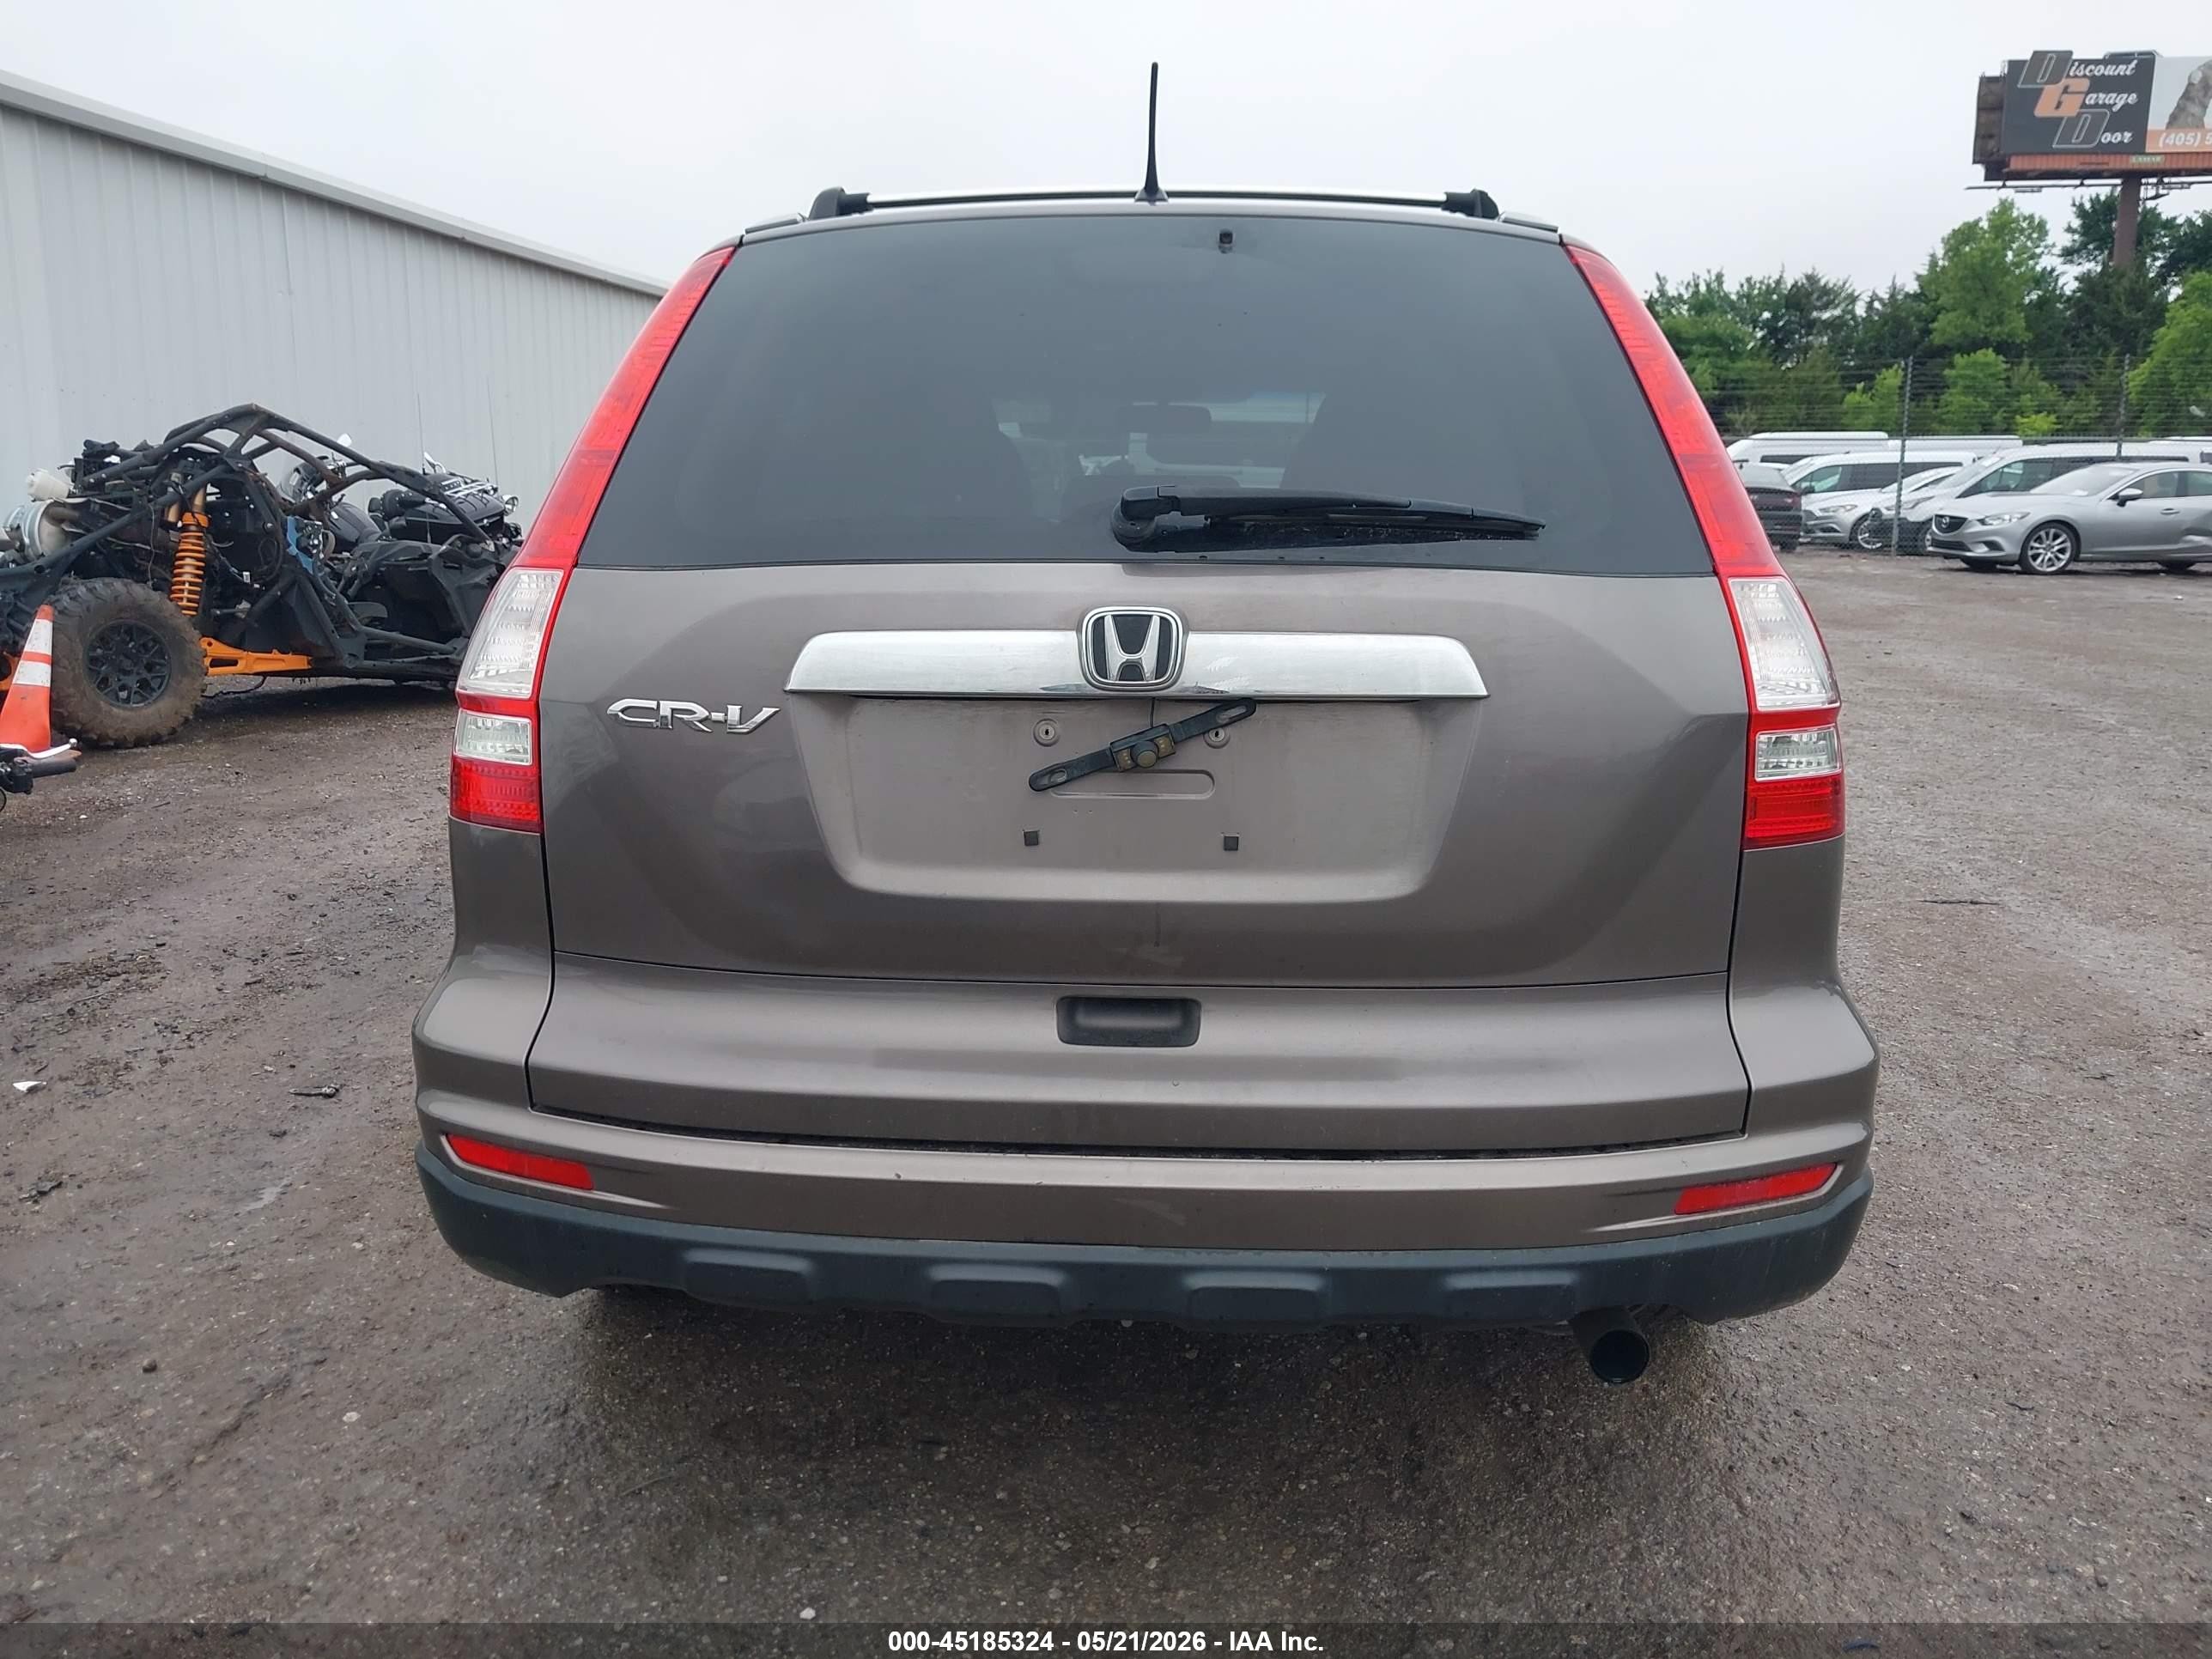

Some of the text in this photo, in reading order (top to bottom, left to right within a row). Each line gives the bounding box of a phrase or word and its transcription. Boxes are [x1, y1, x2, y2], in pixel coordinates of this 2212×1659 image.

[2017, 50, 2136, 88] Discount
[2033, 77, 2138, 118] Garage
[2052, 109, 2133, 148] Door
[2159, 132, 2201, 148] (405)
[607, 699, 781, 734] CR-V
